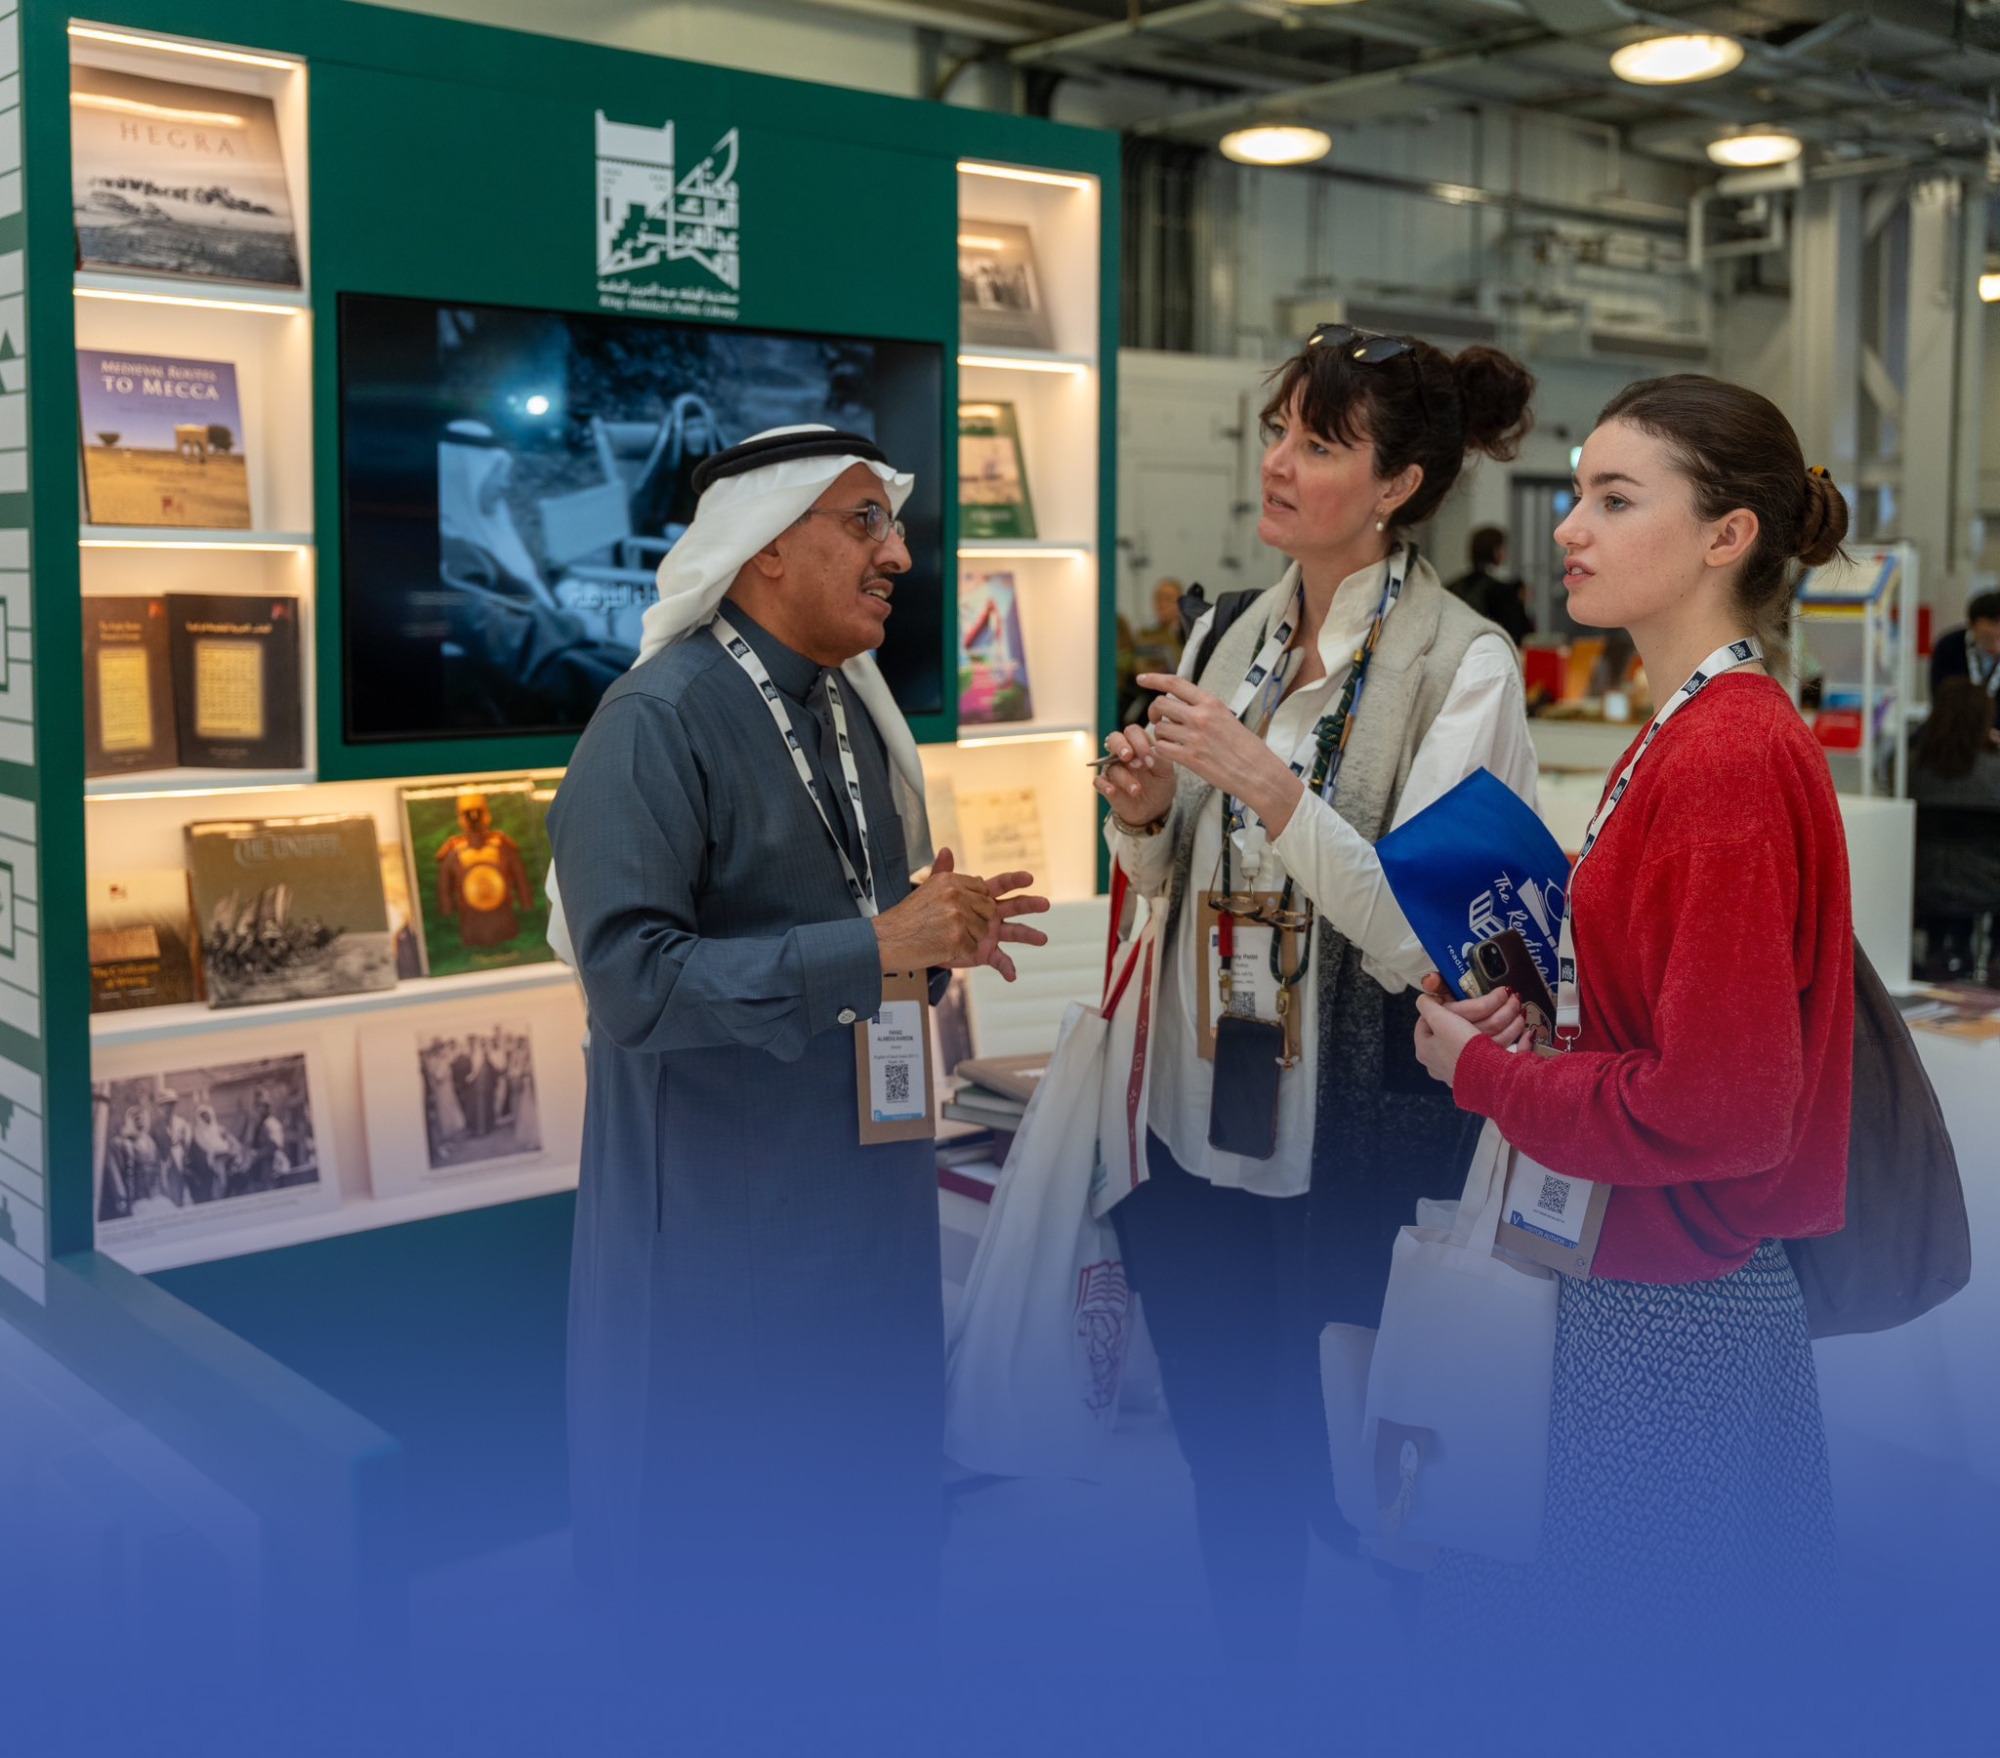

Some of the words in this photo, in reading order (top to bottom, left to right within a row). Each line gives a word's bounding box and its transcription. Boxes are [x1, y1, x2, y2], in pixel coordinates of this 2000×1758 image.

[120, 120, 235, 157] HEGRA
[102, 375, 134, 394] TO
[142, 377, 220, 401] MECCA
[1493, 870, 1513, 904] The
[1446, 944, 1466, 975] readin
[1513, 1214, 1521, 1225] V
[1524, 1224, 1543, 1236] VISITOR
[1544, 1232, 1565, 1245] AUTHOR
